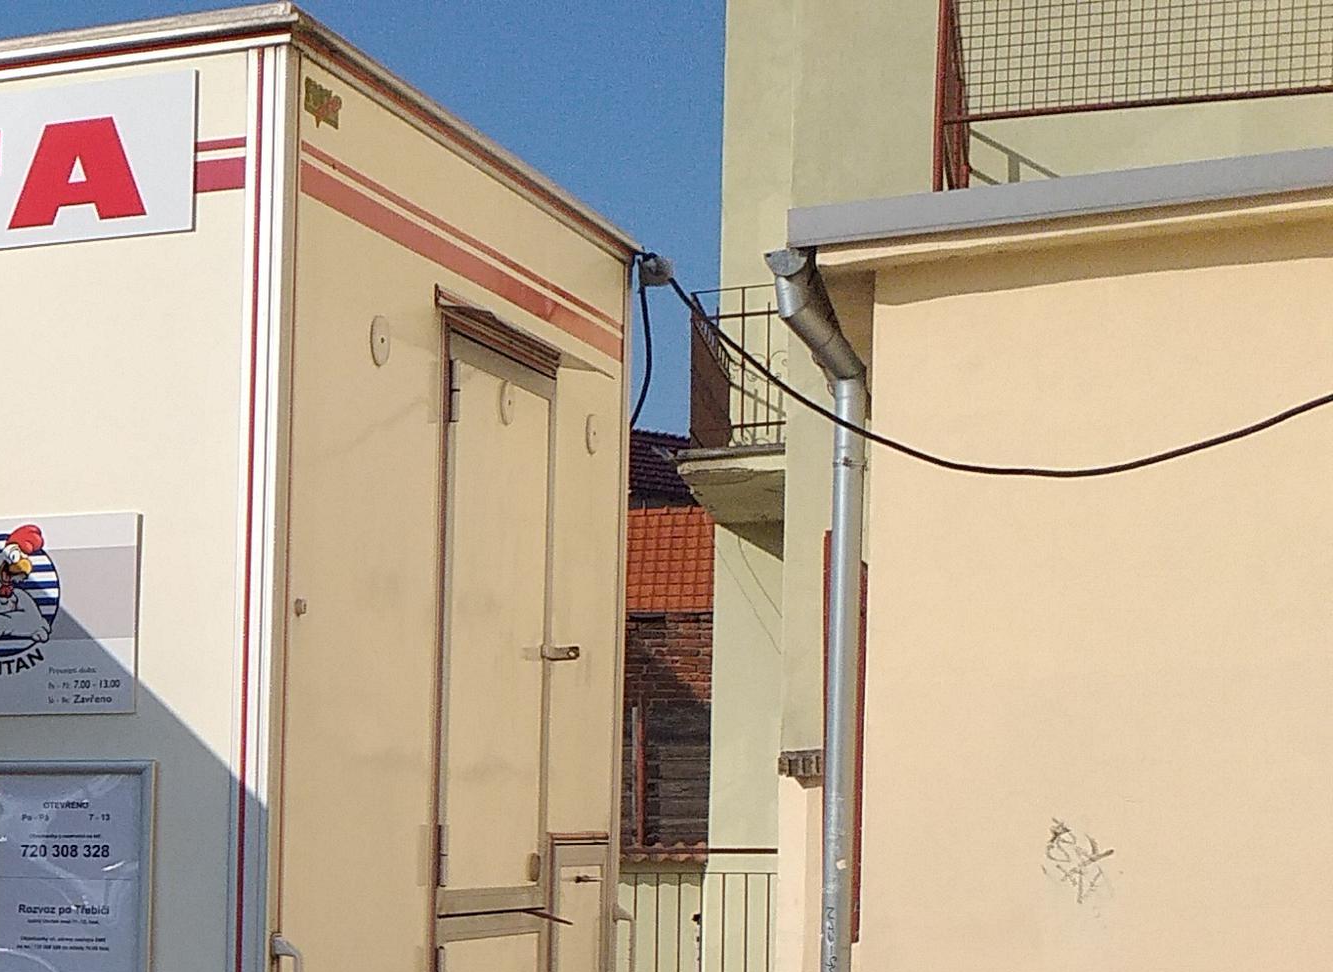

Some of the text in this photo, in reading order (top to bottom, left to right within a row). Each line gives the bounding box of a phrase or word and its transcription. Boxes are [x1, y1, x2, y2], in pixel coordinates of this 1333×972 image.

[73, 680, 91, 689] 7.00
[99, 679, 121, 688] 13.00
[73, 694, 113, 704] Zavřeno
[89, 813, 95, 821] 7
[101, 813, 111, 821] 13
[21, 844, 110, 858] 720 308 328
[18, 903, 56, 914] Rozvoz
[58, 906, 72, 916] po
